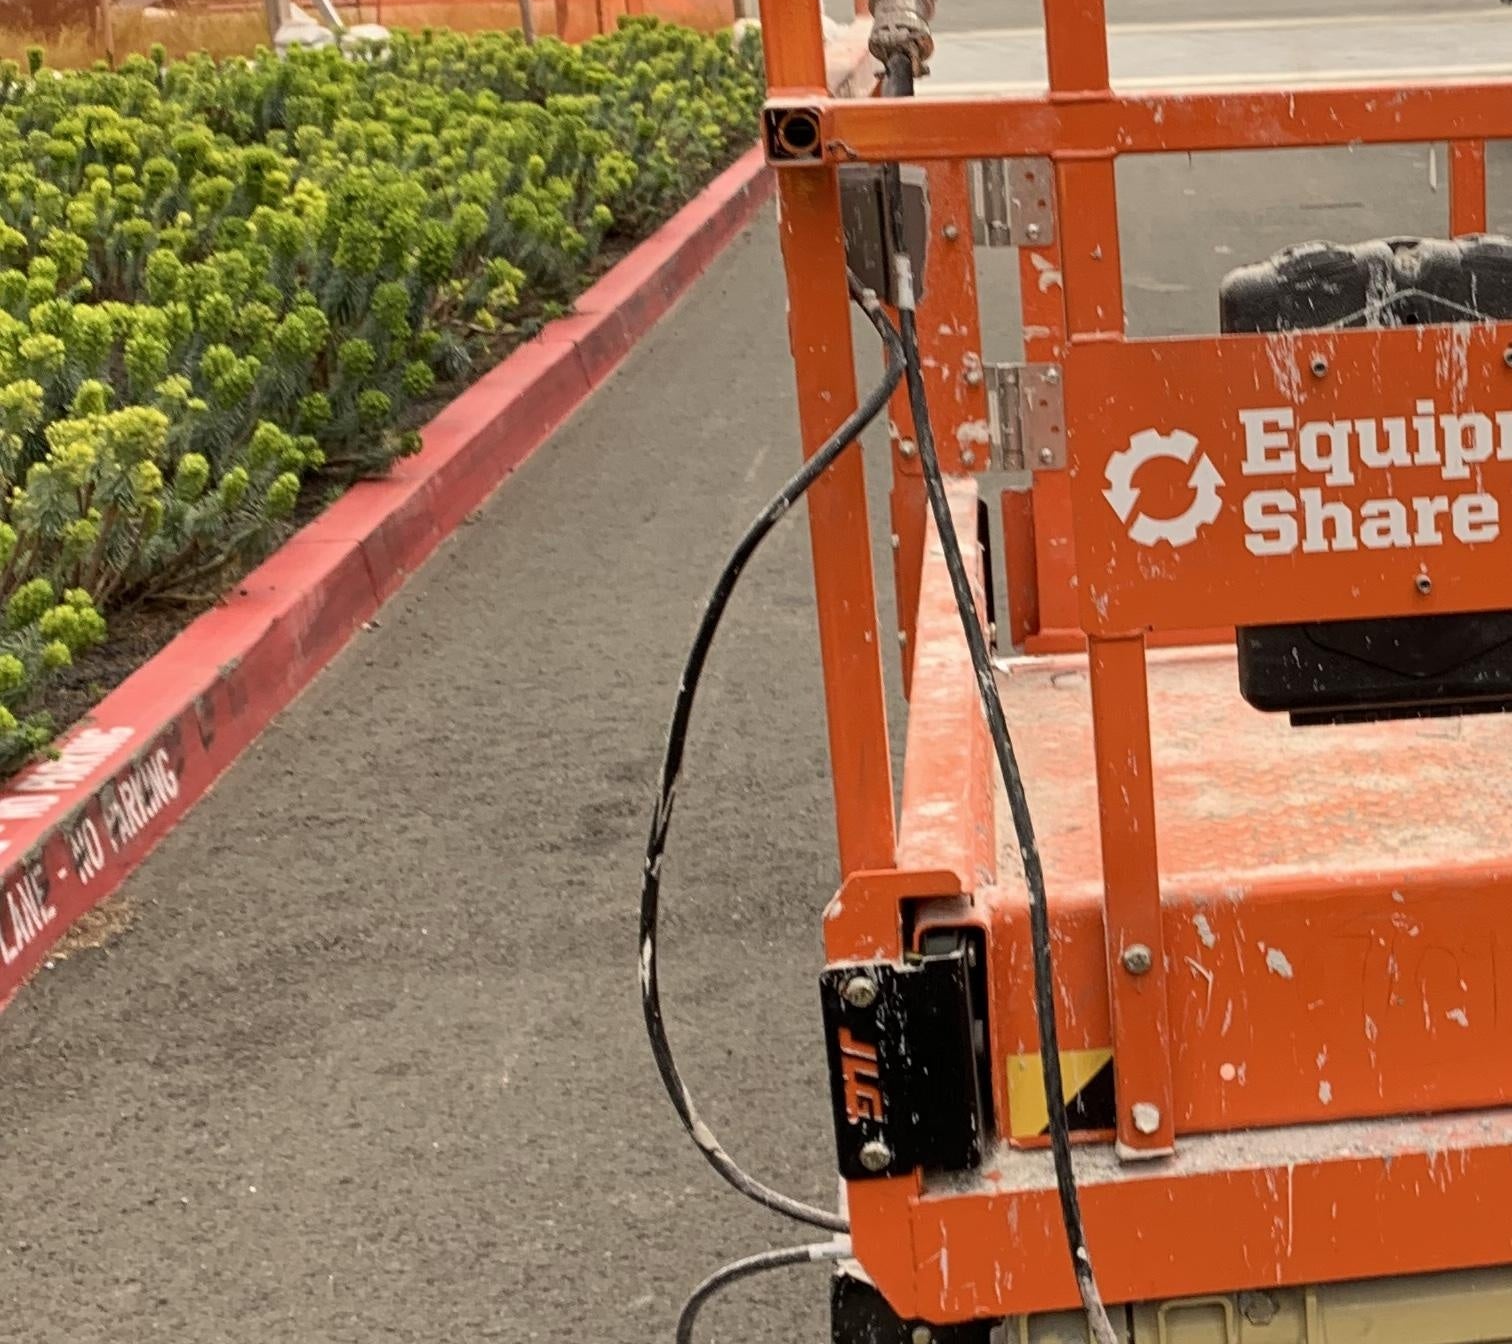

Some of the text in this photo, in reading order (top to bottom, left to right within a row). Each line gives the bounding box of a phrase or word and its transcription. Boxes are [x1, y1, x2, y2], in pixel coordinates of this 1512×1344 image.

[1242, 491, 1500, 556] Share
[101, 747, 180, 854] PARKING
[838, 1025, 884, 1125] JLG
